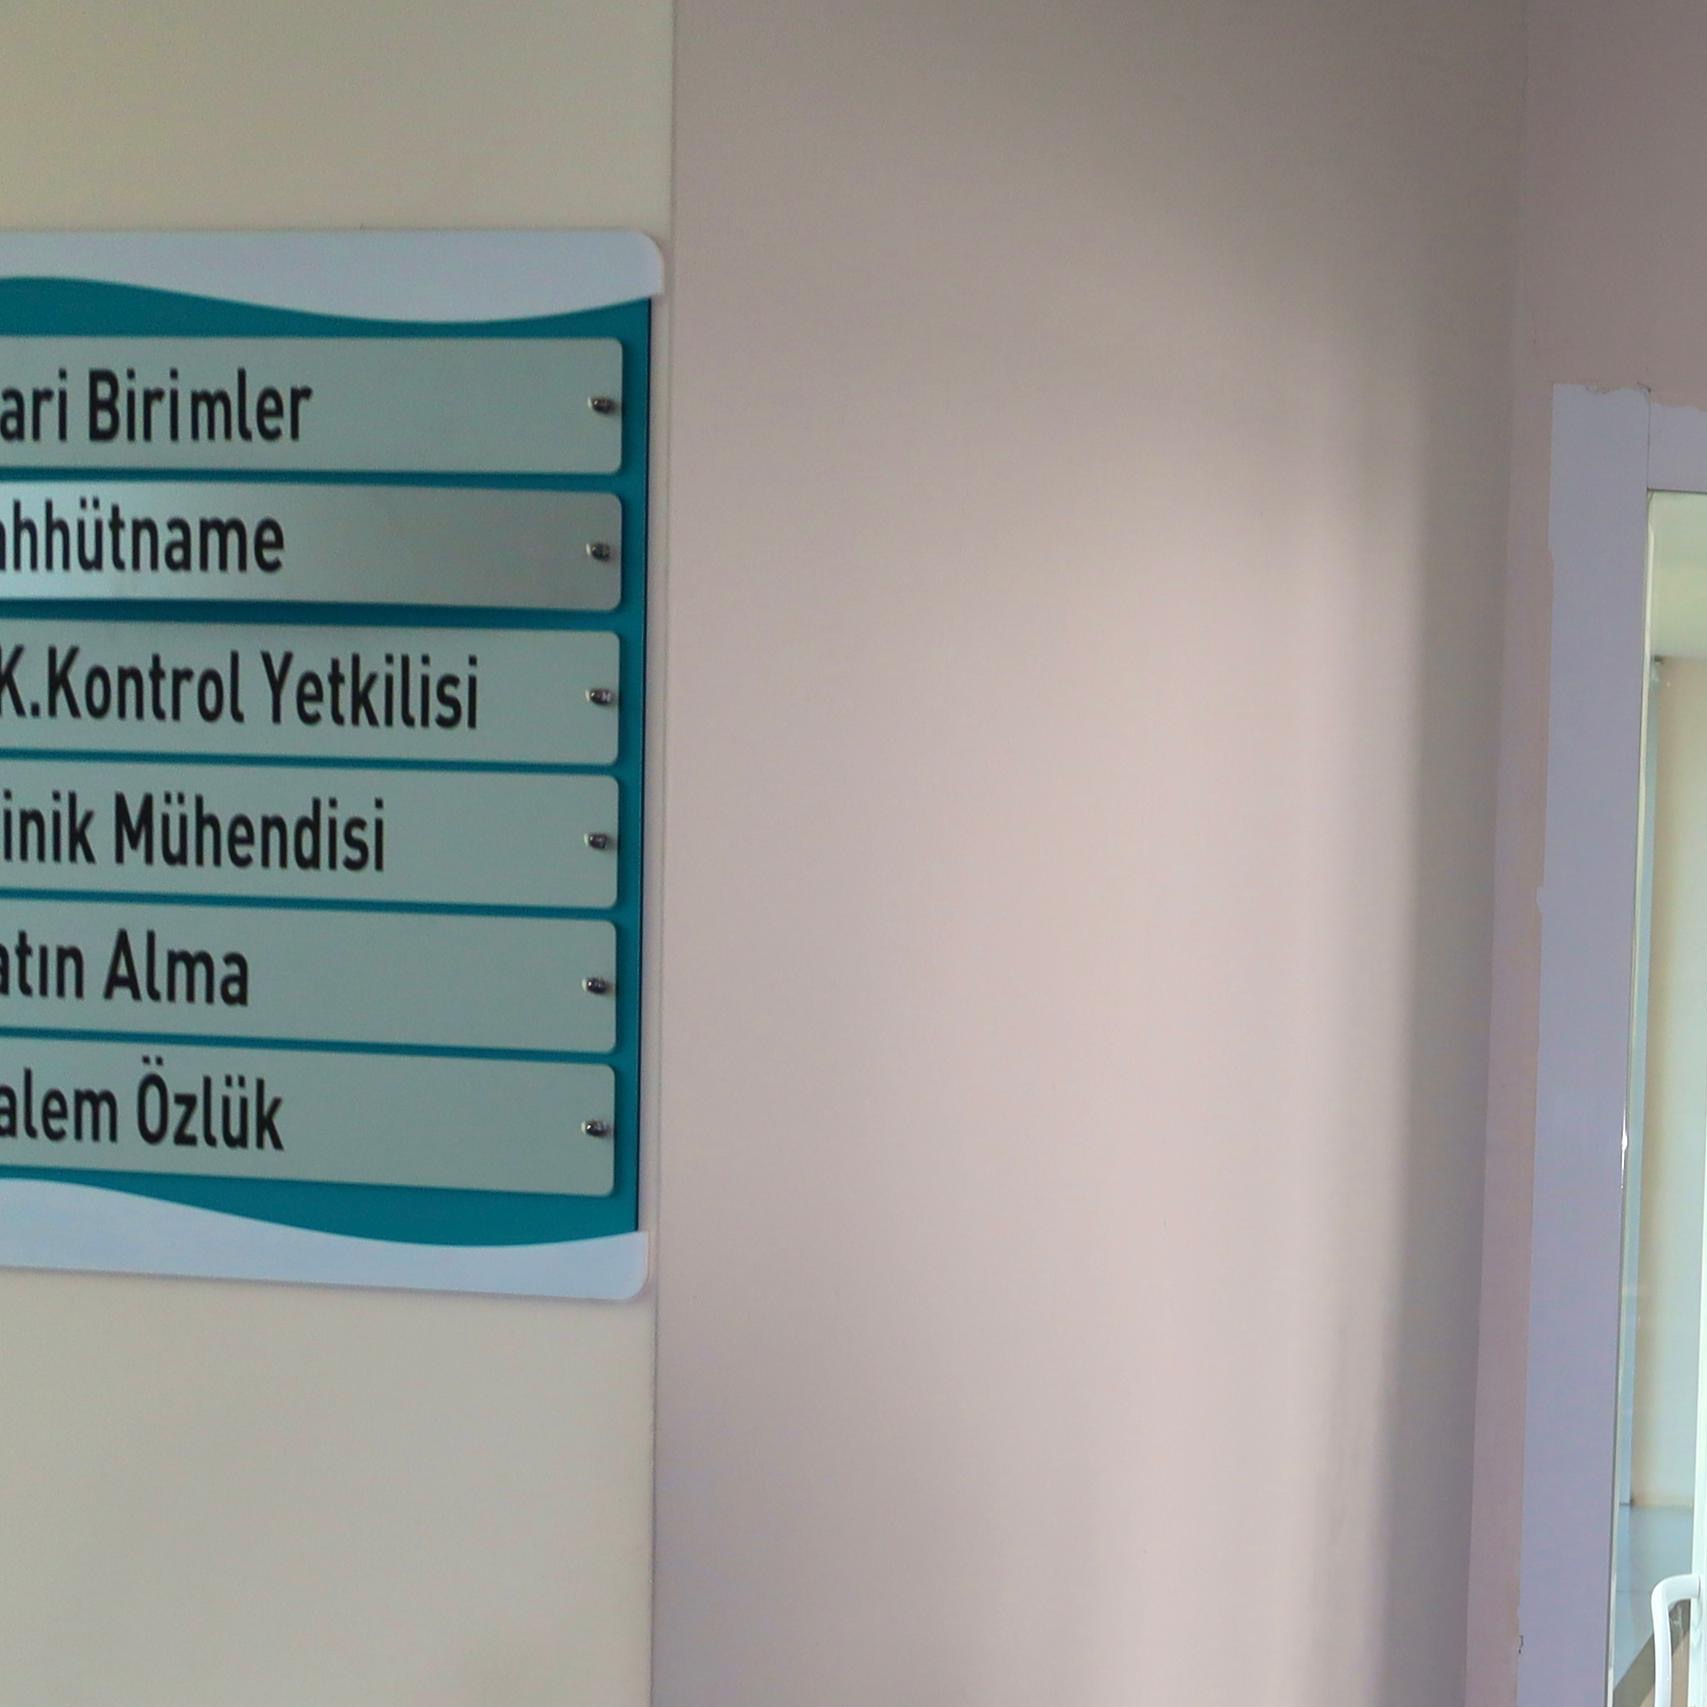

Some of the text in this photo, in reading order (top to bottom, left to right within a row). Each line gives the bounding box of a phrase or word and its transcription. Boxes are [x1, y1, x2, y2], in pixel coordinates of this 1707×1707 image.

[0, 367, 313, 443] ari Birimler
[0, 496, 285, 574] hhütname
[0, 645, 478, 730] K.Kontrol Yetkilisi
[3, 789, 385, 872] inik Mühendisi
[103, 928, 250, 1007] Alma
[137, 1055, 285, 1151] Özlük
